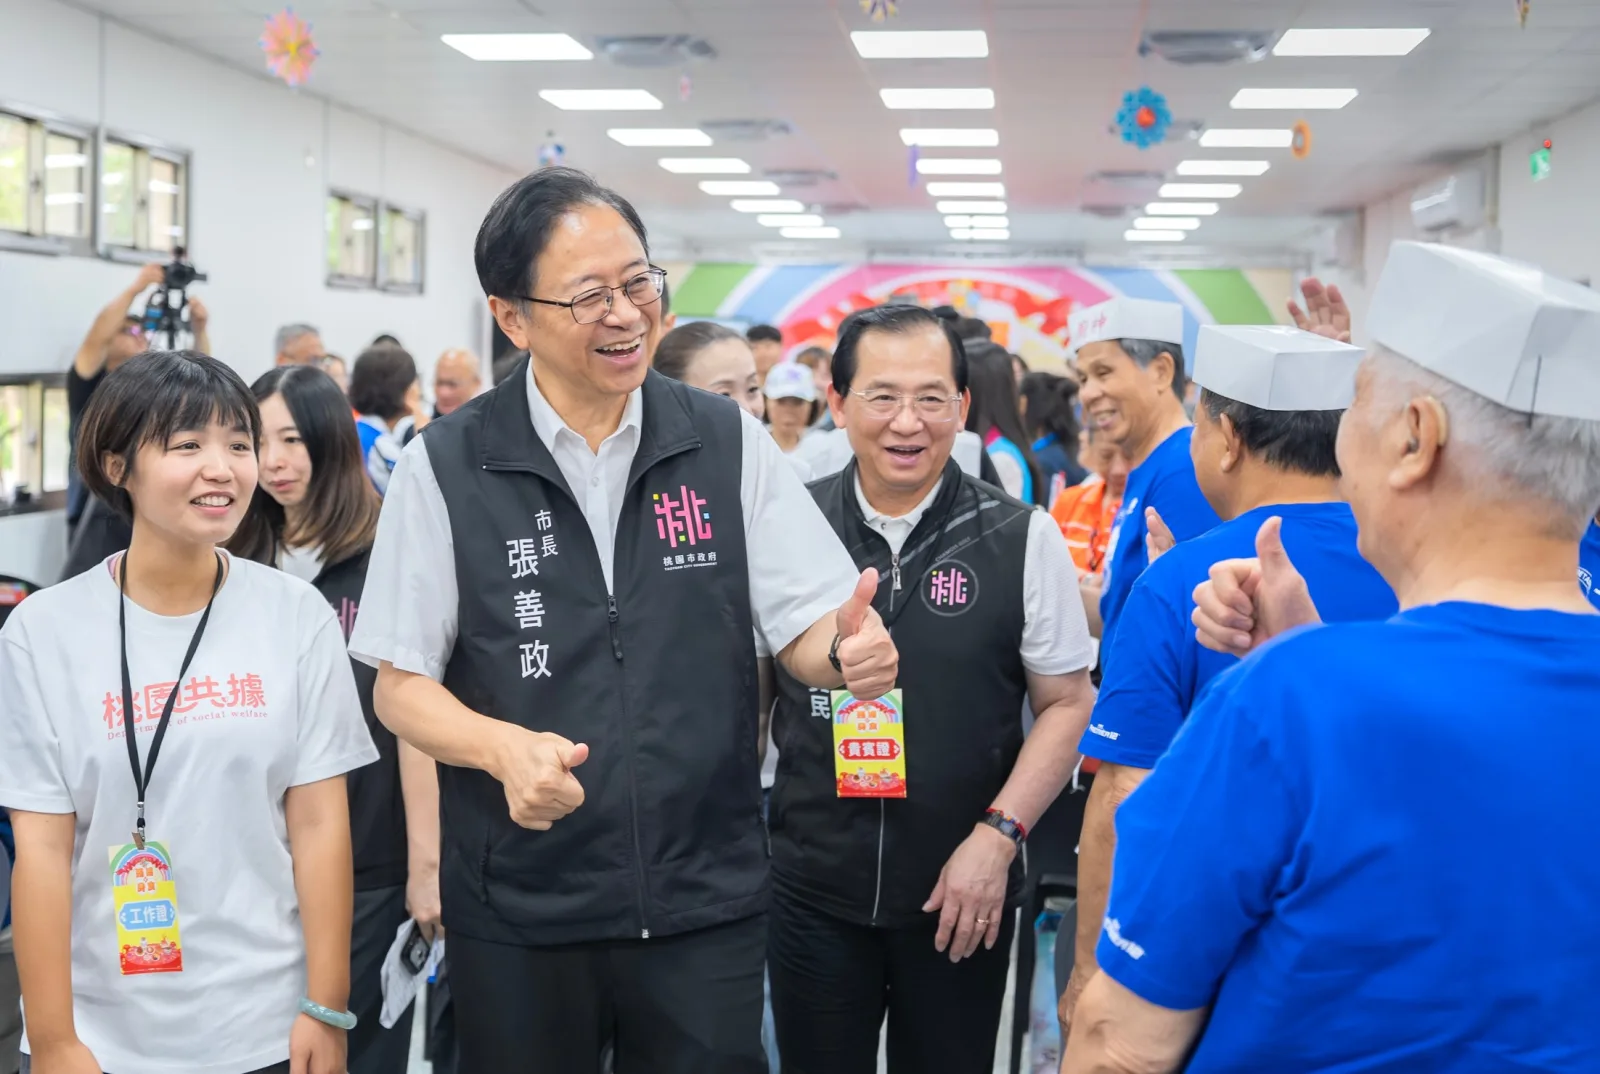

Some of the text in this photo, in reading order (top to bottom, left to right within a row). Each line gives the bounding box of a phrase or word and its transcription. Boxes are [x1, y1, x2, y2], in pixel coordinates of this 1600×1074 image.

[535, 509, 558, 557] 市長
[663, 552, 717, 567] 桃園市政府
[506, 538, 552, 679] 張善政
[808, 687, 831, 719] 民
[107, 708, 268, 740] Deprtmet of social welfare
[848, 742, 891, 757] 貴賓證
